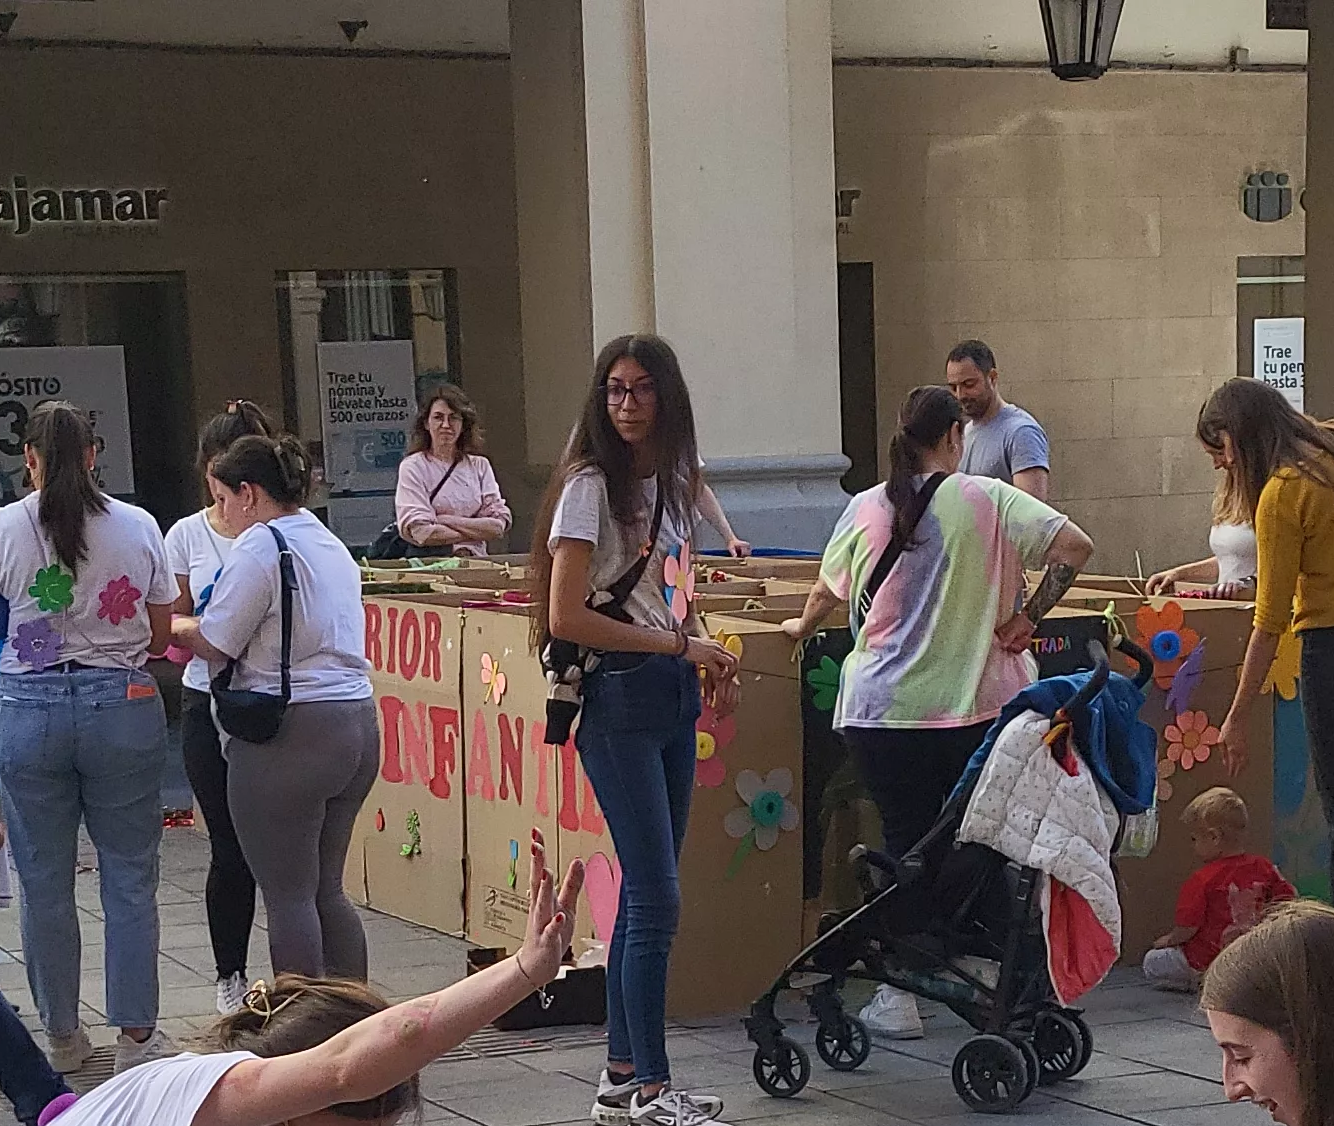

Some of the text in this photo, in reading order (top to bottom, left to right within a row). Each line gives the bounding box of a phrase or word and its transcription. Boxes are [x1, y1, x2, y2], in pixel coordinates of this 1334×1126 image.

[1263, 345, 1292, 359] Trae
[1264, 361, 1278, 374] tu
[327, 371, 372, 385] Trae tu
[328, 384, 386, 398] nómina y
[374, 396, 408, 409] hasta
[329, 410, 353, 423] 500
[380, 431, 406, 446] 500
